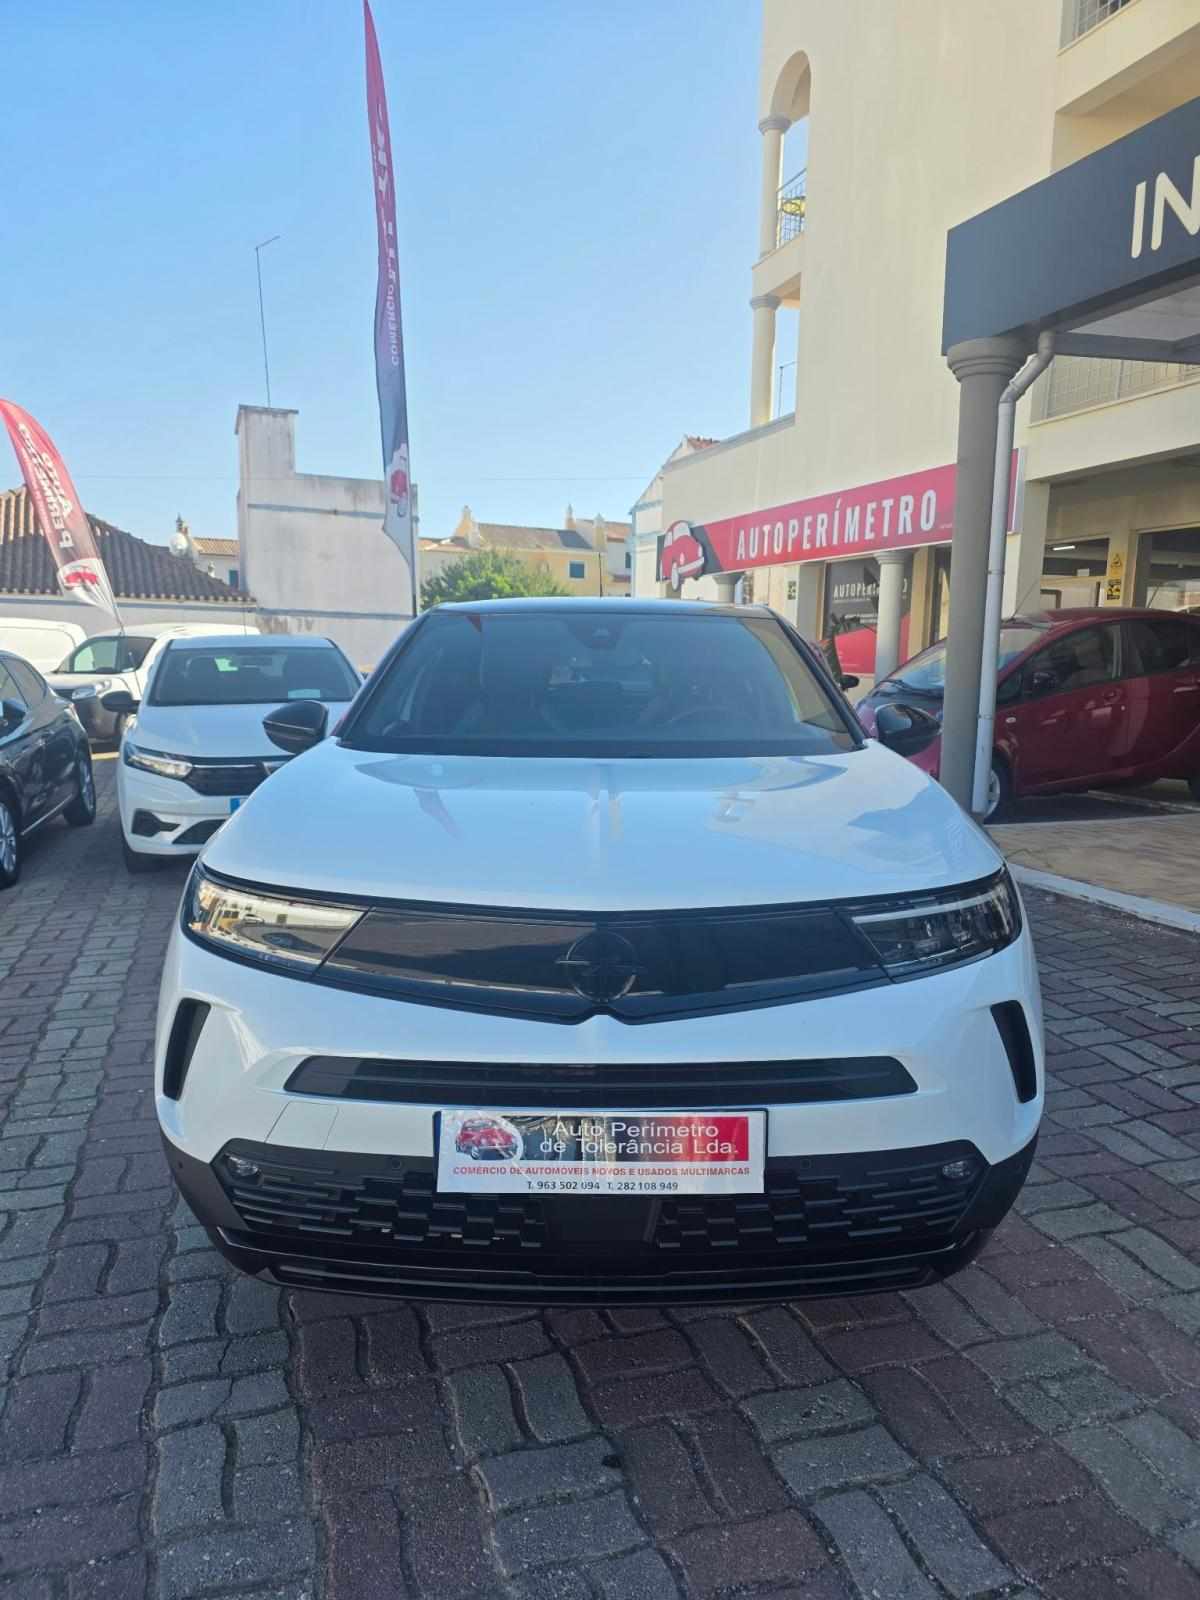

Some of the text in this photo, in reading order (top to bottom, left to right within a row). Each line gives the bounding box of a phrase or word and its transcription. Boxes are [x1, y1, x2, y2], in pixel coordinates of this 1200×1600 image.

[736, 488, 937, 561] AUTOPERÍMETRO
[552, 1121, 719, 1138] Auto Perímetro
[540, 1138, 739, 1154] de Tolerância Lda.
[592, 1166, 626, 1176] NOVOS
[628, 1167, 636, 1176] E
[638, 1167, 679, 1176] USADOS
[680, 1166, 750, 1176] MULTIMARCAS
[537, 1181, 556, 1190] 963
[559, 1181, 578, 1190] 502
[581, 1181, 600, 1190] 094
[617, 1182, 635, 1191] 282
[638, 1181, 657, 1191] 108
[659, 1181, 679, 1190] 949
